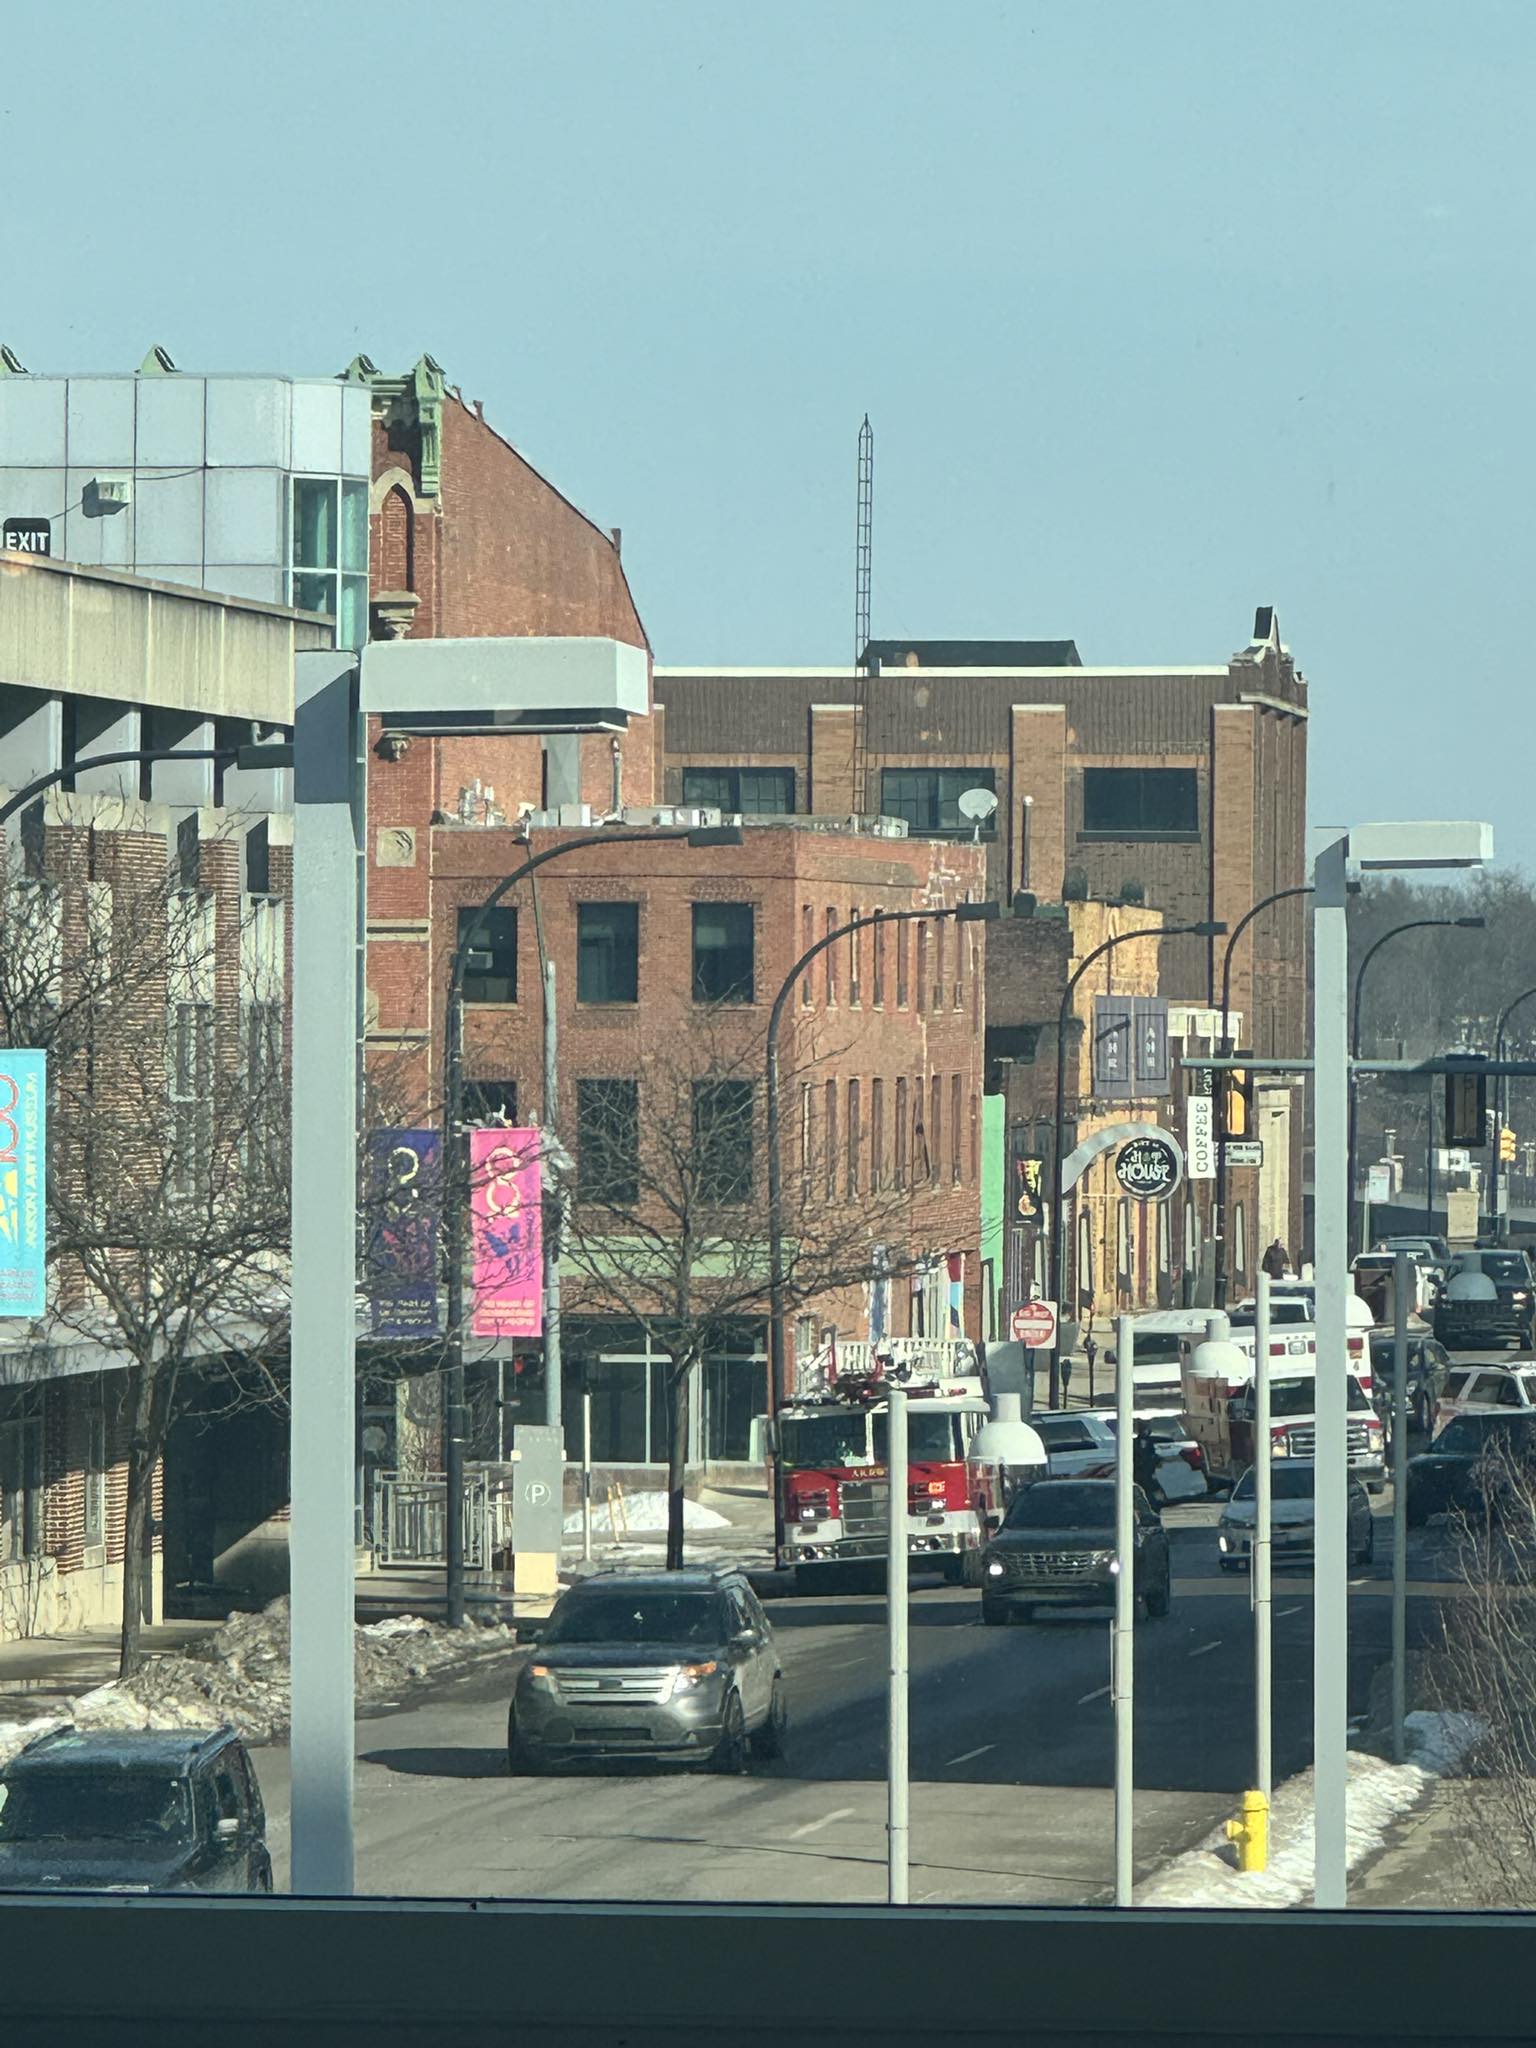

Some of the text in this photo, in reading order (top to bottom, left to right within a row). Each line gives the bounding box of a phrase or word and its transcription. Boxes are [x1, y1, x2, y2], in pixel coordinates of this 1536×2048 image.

[6, 531, 49, 551] EXIT
[24, 1072, 38, 1150] MUSEUM
[1195, 1103, 1209, 1172] COFFEE
[24, 1152, 38, 1189] ART
[1117, 1162, 1172, 1182] HOUSE
[531, 1484, 545, 1504] P
